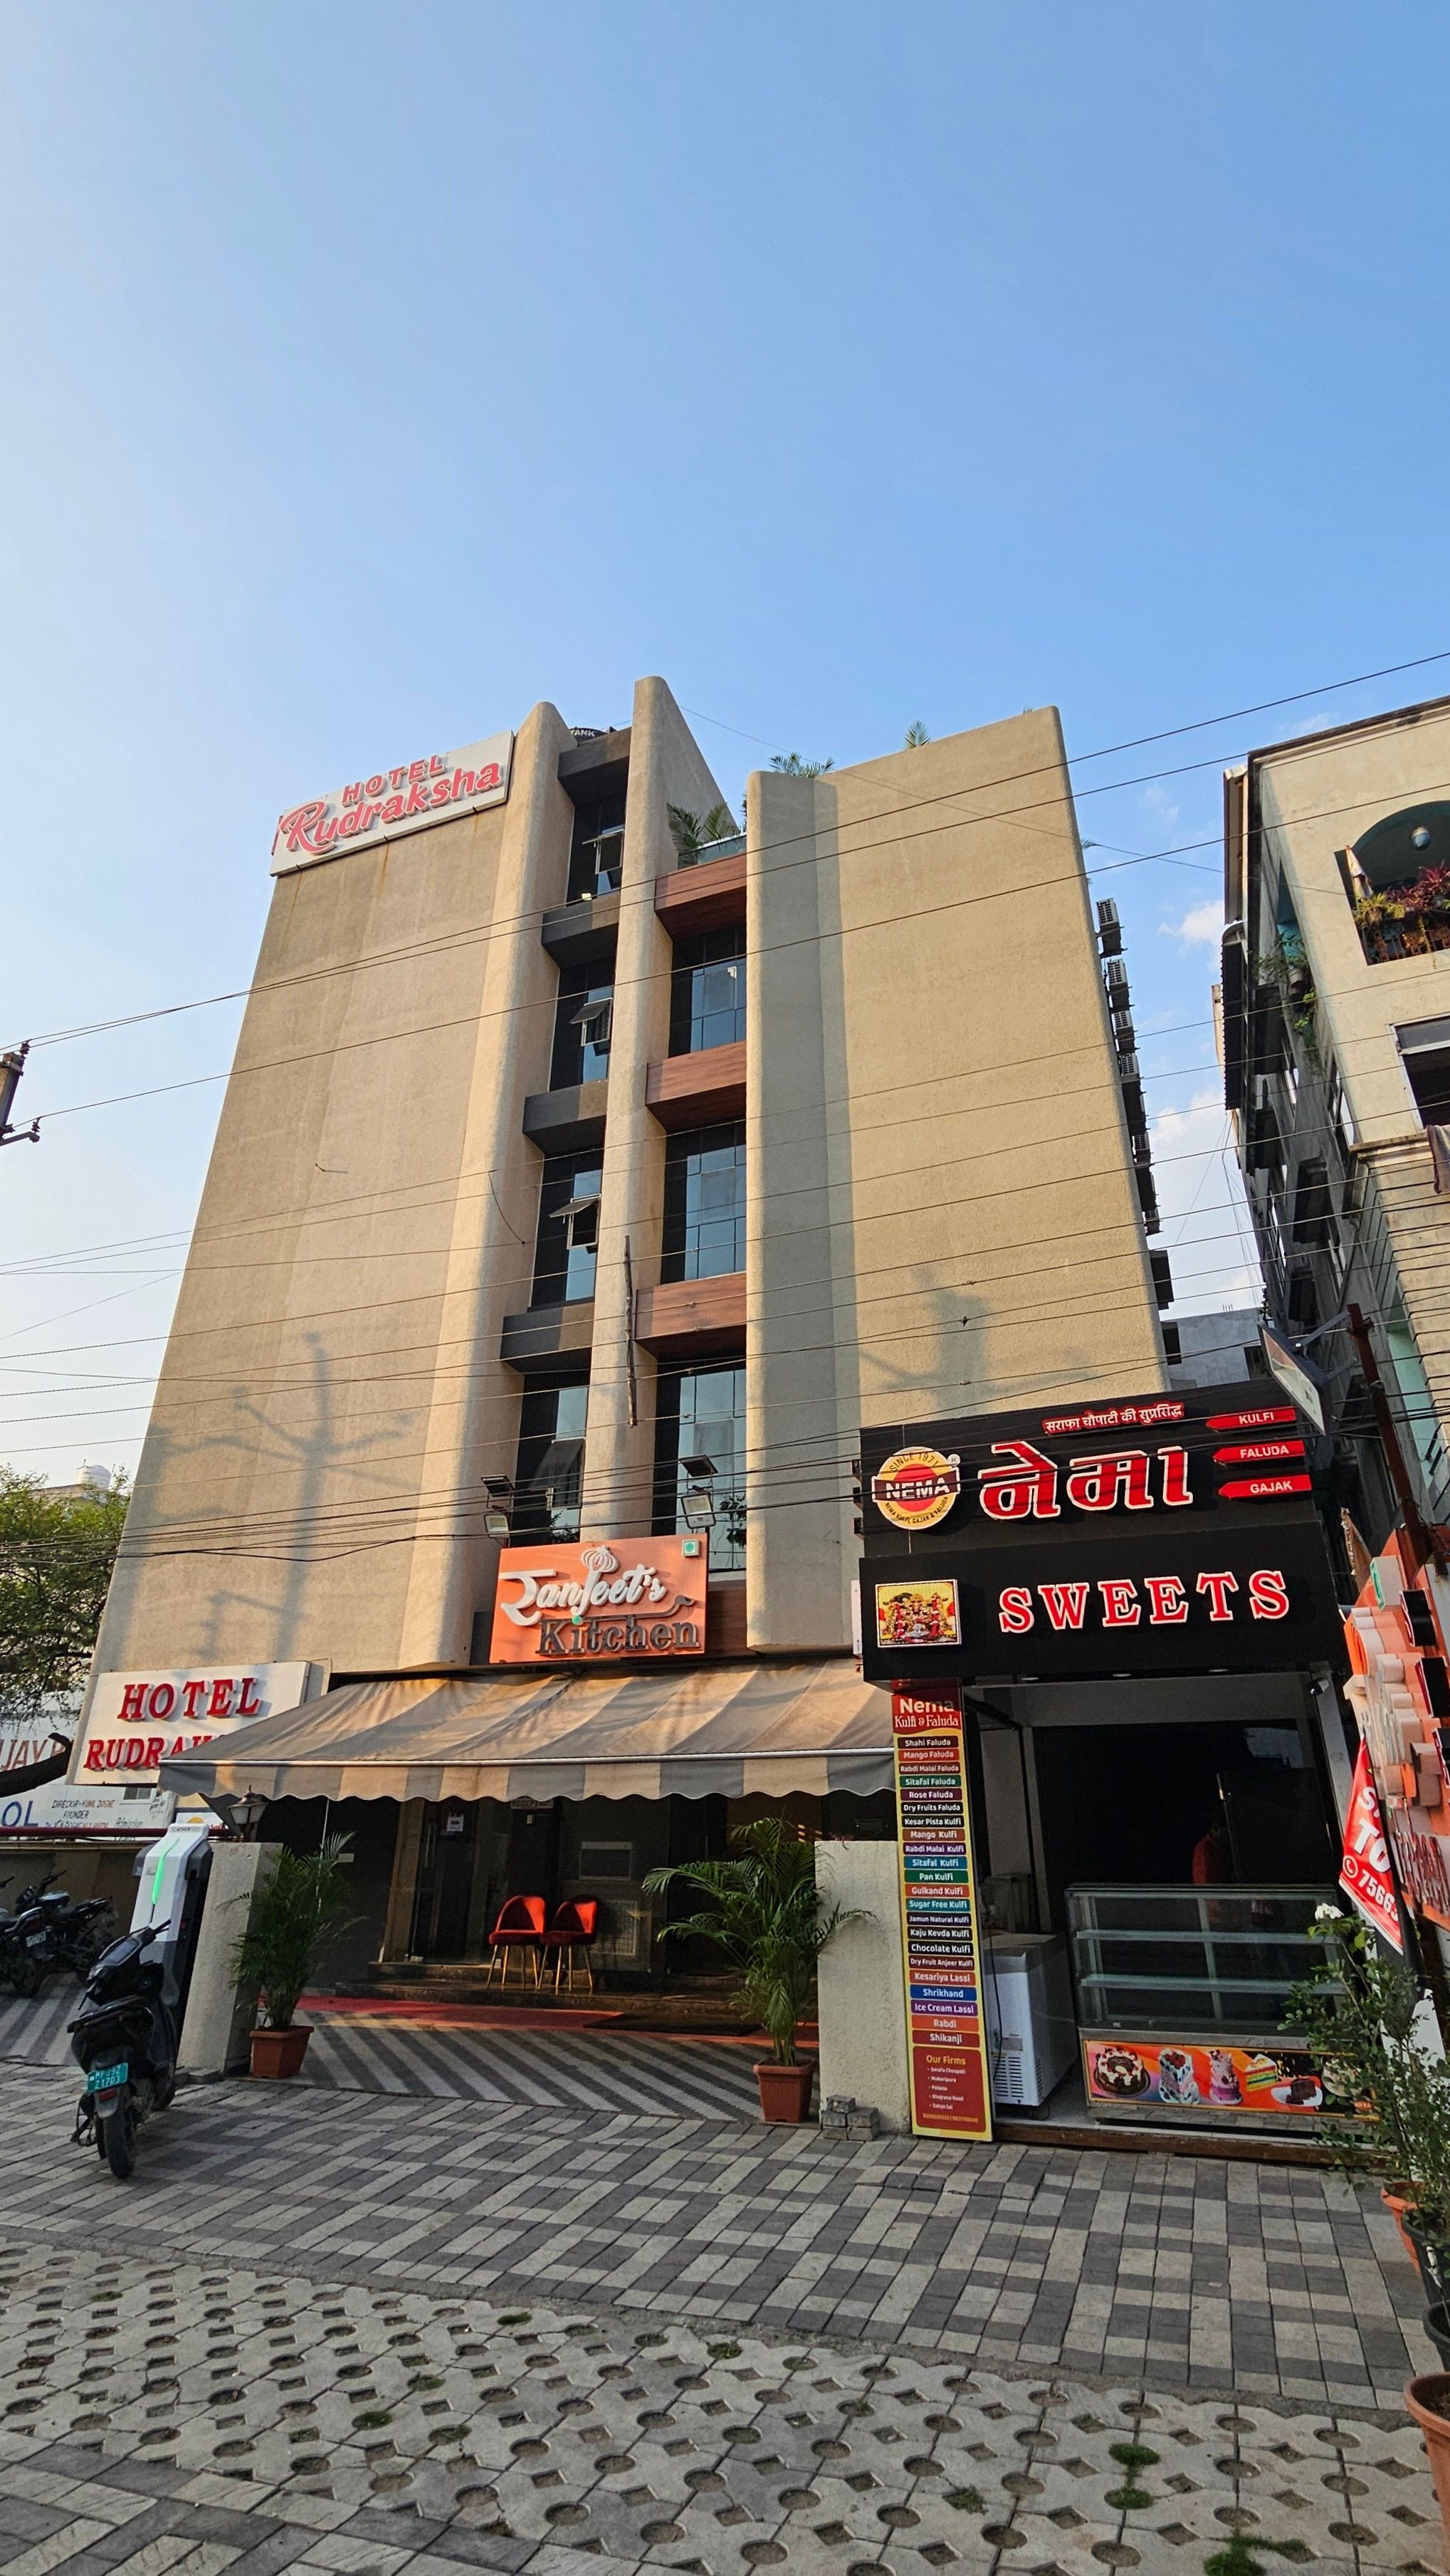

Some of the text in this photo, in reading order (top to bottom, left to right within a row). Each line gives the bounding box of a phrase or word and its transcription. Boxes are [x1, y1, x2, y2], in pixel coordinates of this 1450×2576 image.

[342, 755, 446, 808] HOTEL
[280, 763, 502, 854] Rudraksha
[1045, 1403, 1182, 1433] सराफा चौपाटी की सुप्रसिद्ध
[1238, 1412, 1274, 1424] KULFI
[1239, 1445, 1289, 1458] FALUDA
[890, 1452, 939, 1472] SINCE 1971
[978, 1440, 1194, 1521] नेमा
[886, 1477, 950, 1499] NEMA
[1249, 1481, 1293, 1494] GAJAK
[999, 1570, 1291, 1634] SWEETS
[535, 1613, 700, 1656] Kitchen
[117, 1677, 262, 1720] HOTEL
[900, 1698, 955, 1714] Nema
[895, 1715, 917, 1728] Kulfi
[926, 1714, 959, 1727] Faluda
[910, 1831, 936, 1839] Mango
[909, 1900, 930, 1909] Sugar
[910, 1929, 926, 1937] Kaju
[911, 1944, 950, 1952] Chocolate
[914, 1972, 970, 1982] Kesariya Lassi
[923, 1988, 964, 1998] Shrikhand
[927, 2004, 952, 2012] Cream
[954, 2005, 974, 2014] Lassi
[933, 2019, 957, 2028] Rabdi
[930, 2033, 962, 2044] Shikanji
[926, 2055, 967, 2065] Our Firms
